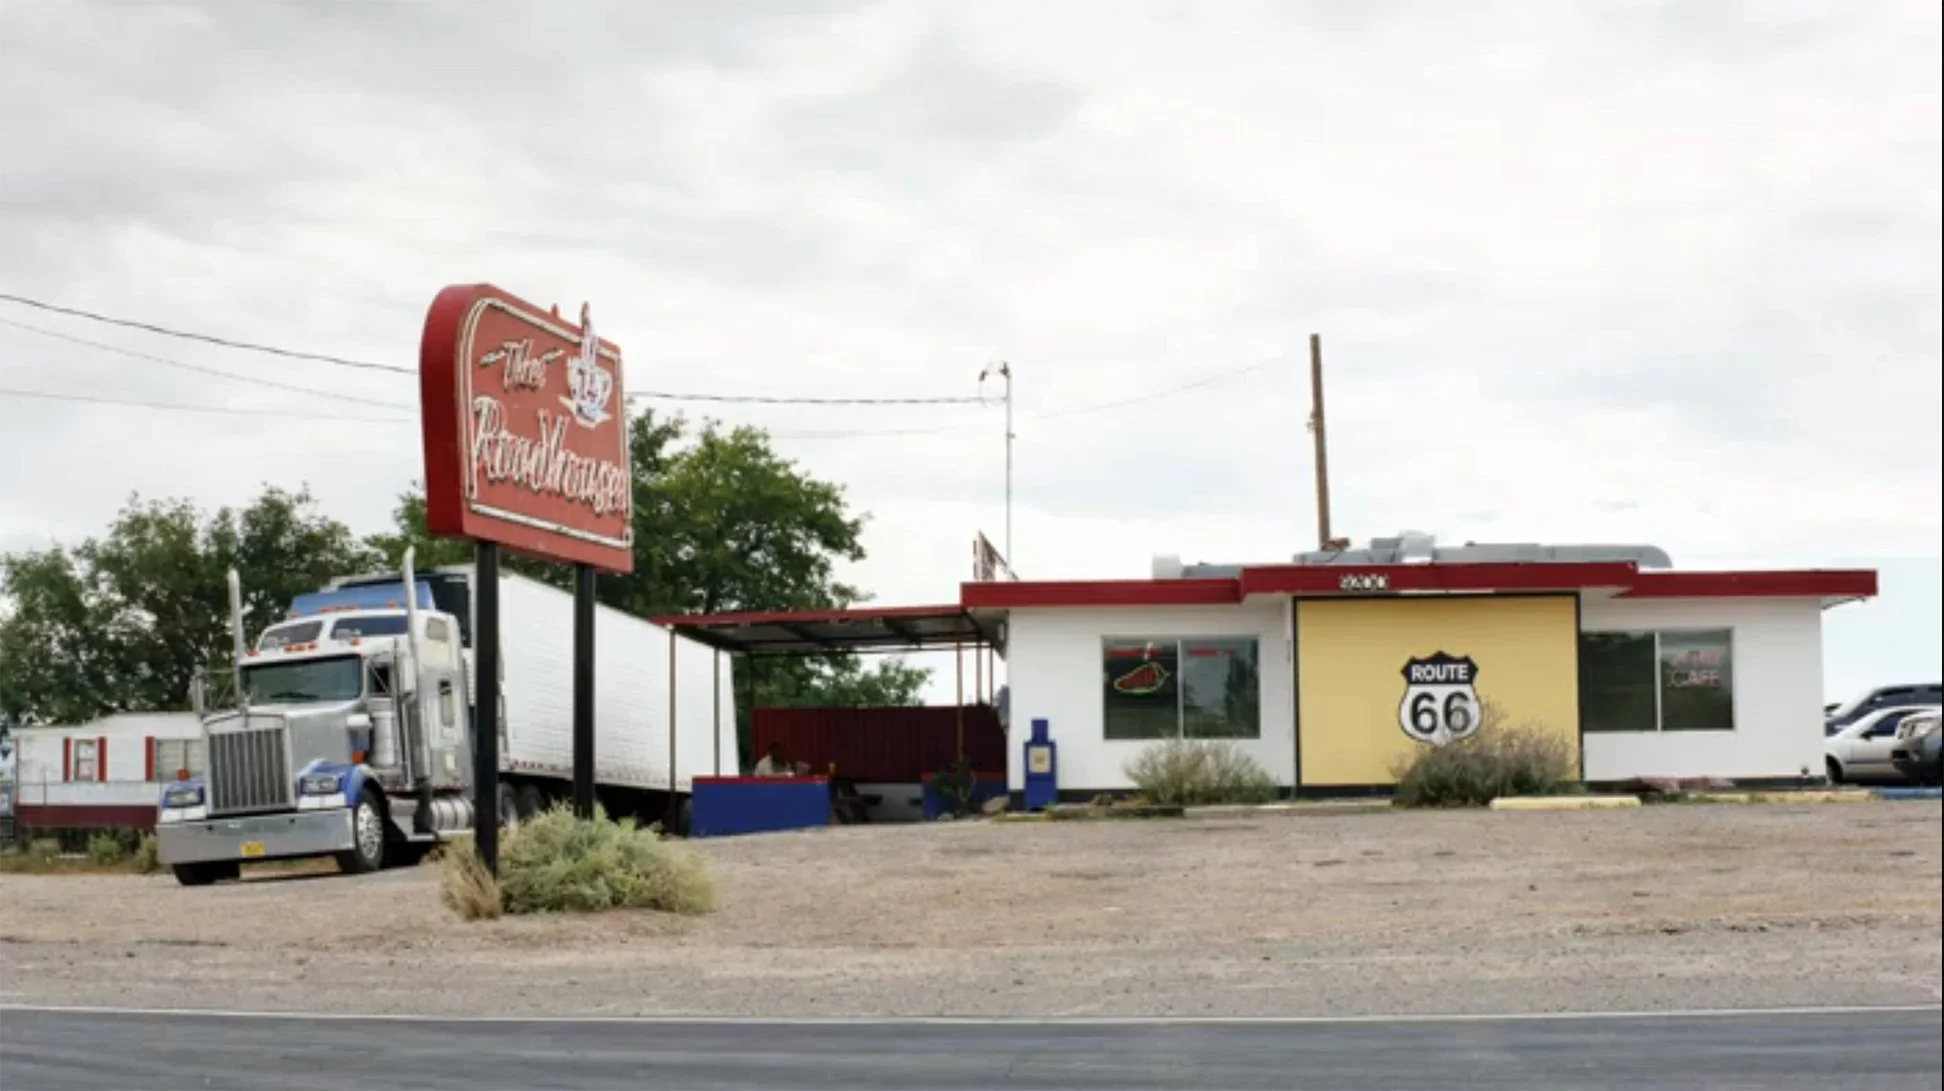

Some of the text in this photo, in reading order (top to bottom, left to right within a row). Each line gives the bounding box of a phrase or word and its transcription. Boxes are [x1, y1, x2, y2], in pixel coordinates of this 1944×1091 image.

[487, 338, 560, 391] The
[474, 396, 626, 514] Roadhouse
[1411, 664, 1469, 681] ROUTE
[1411, 691, 1471, 734] 66
